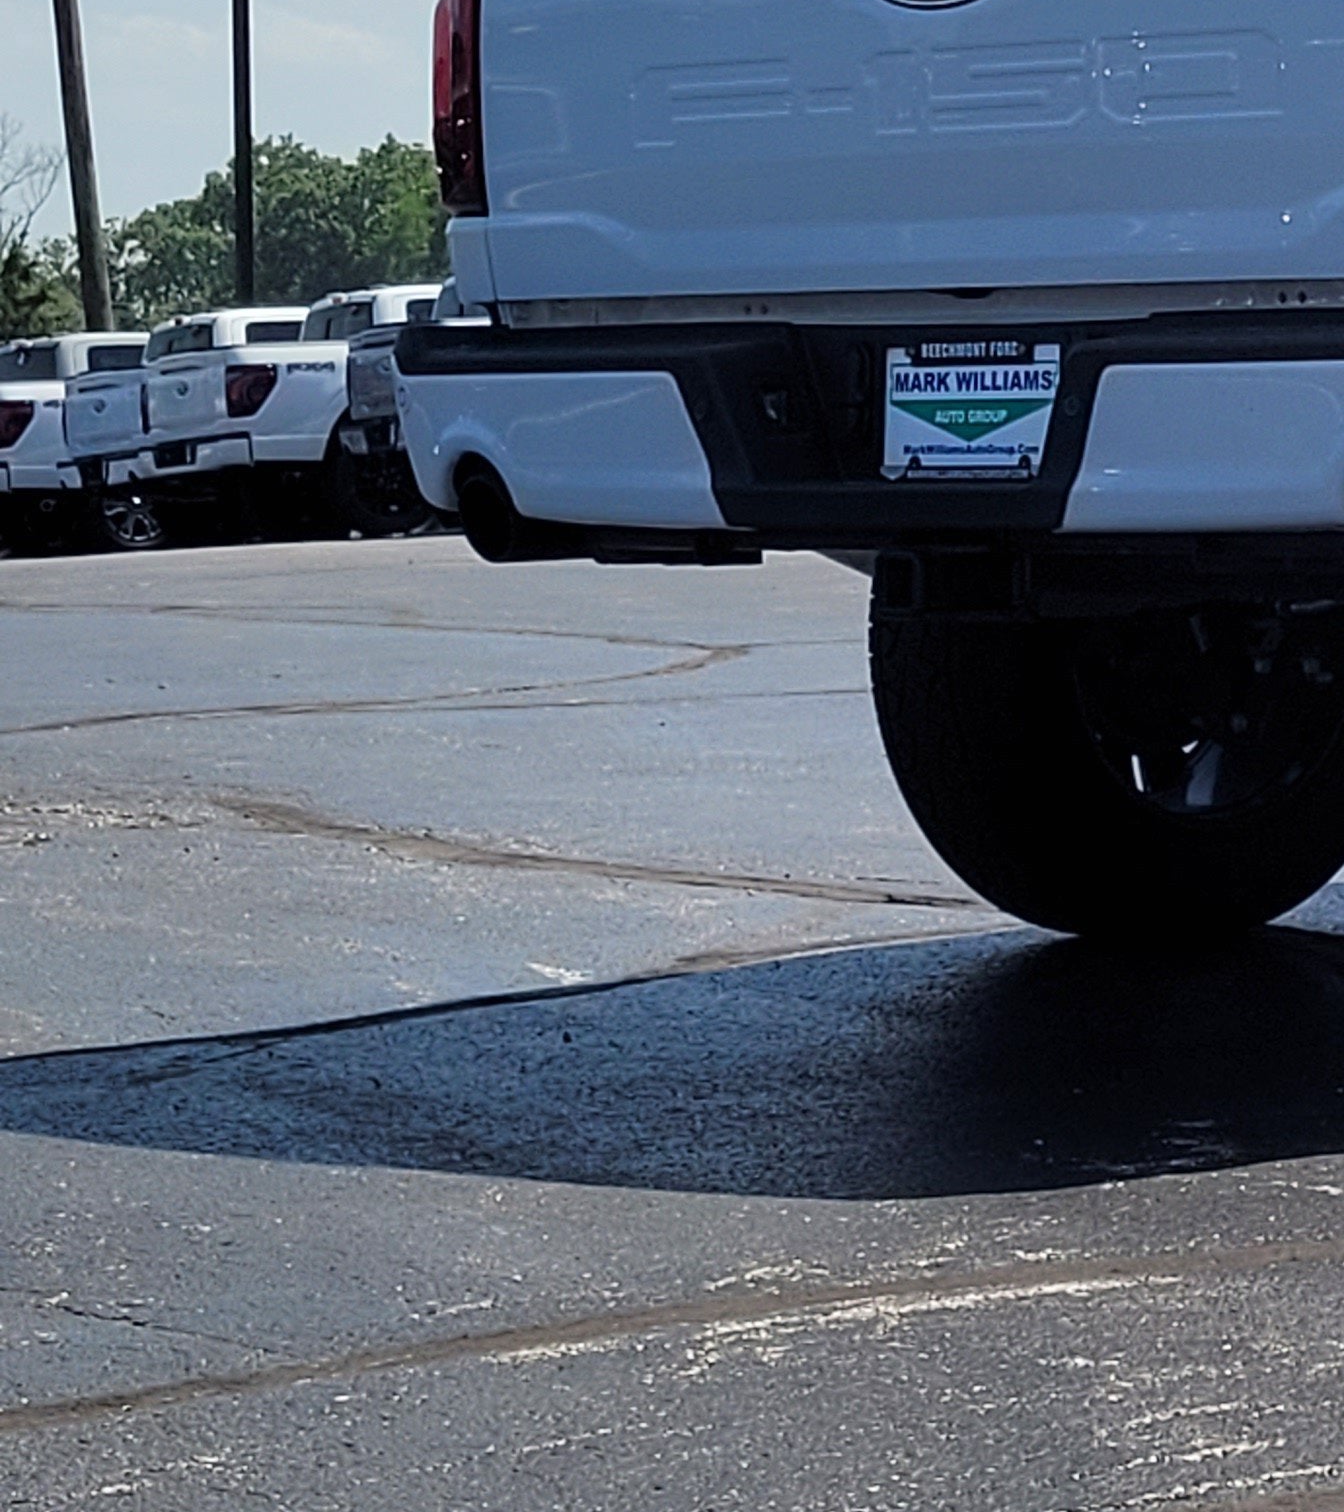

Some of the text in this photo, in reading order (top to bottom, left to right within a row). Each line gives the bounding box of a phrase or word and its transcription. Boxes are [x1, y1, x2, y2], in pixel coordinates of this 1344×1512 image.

[631, 28, 1286, 148] F-150
[921, 342, 986, 358] BEECHMONT
[895, 370, 1053, 393] MARK WILLIAMS
[935, 409, 1008, 423] AUTO GROUP
